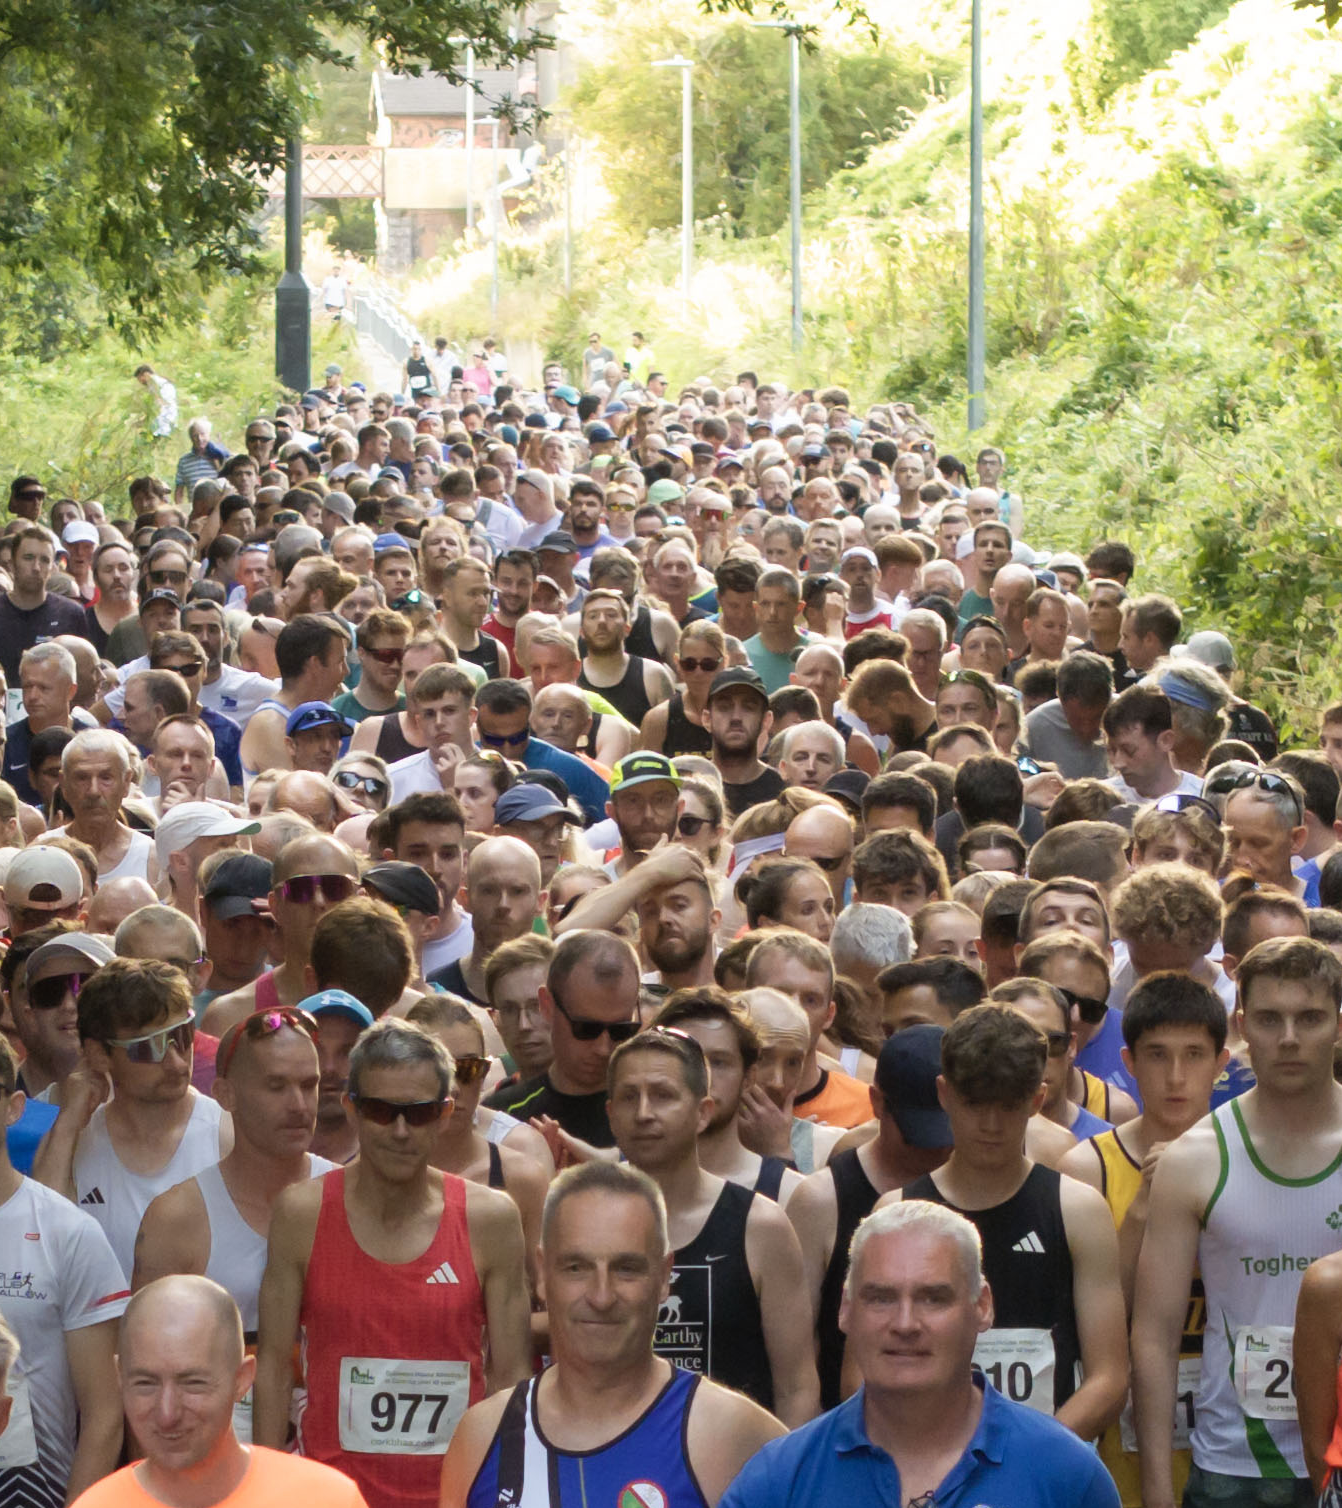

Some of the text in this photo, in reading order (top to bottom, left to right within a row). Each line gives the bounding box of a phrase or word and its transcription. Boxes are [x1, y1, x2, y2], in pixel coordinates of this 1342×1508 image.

[1240, 1253, 1319, 1277] Togher
[654, 1327, 703, 1348] Carthy
[667, 1356, 702, 1369] nce
[971, 1361, 1034, 1402] 10
[1265, 1358, 1296, 1400] 2
[371, 1392, 449, 1434] 977
